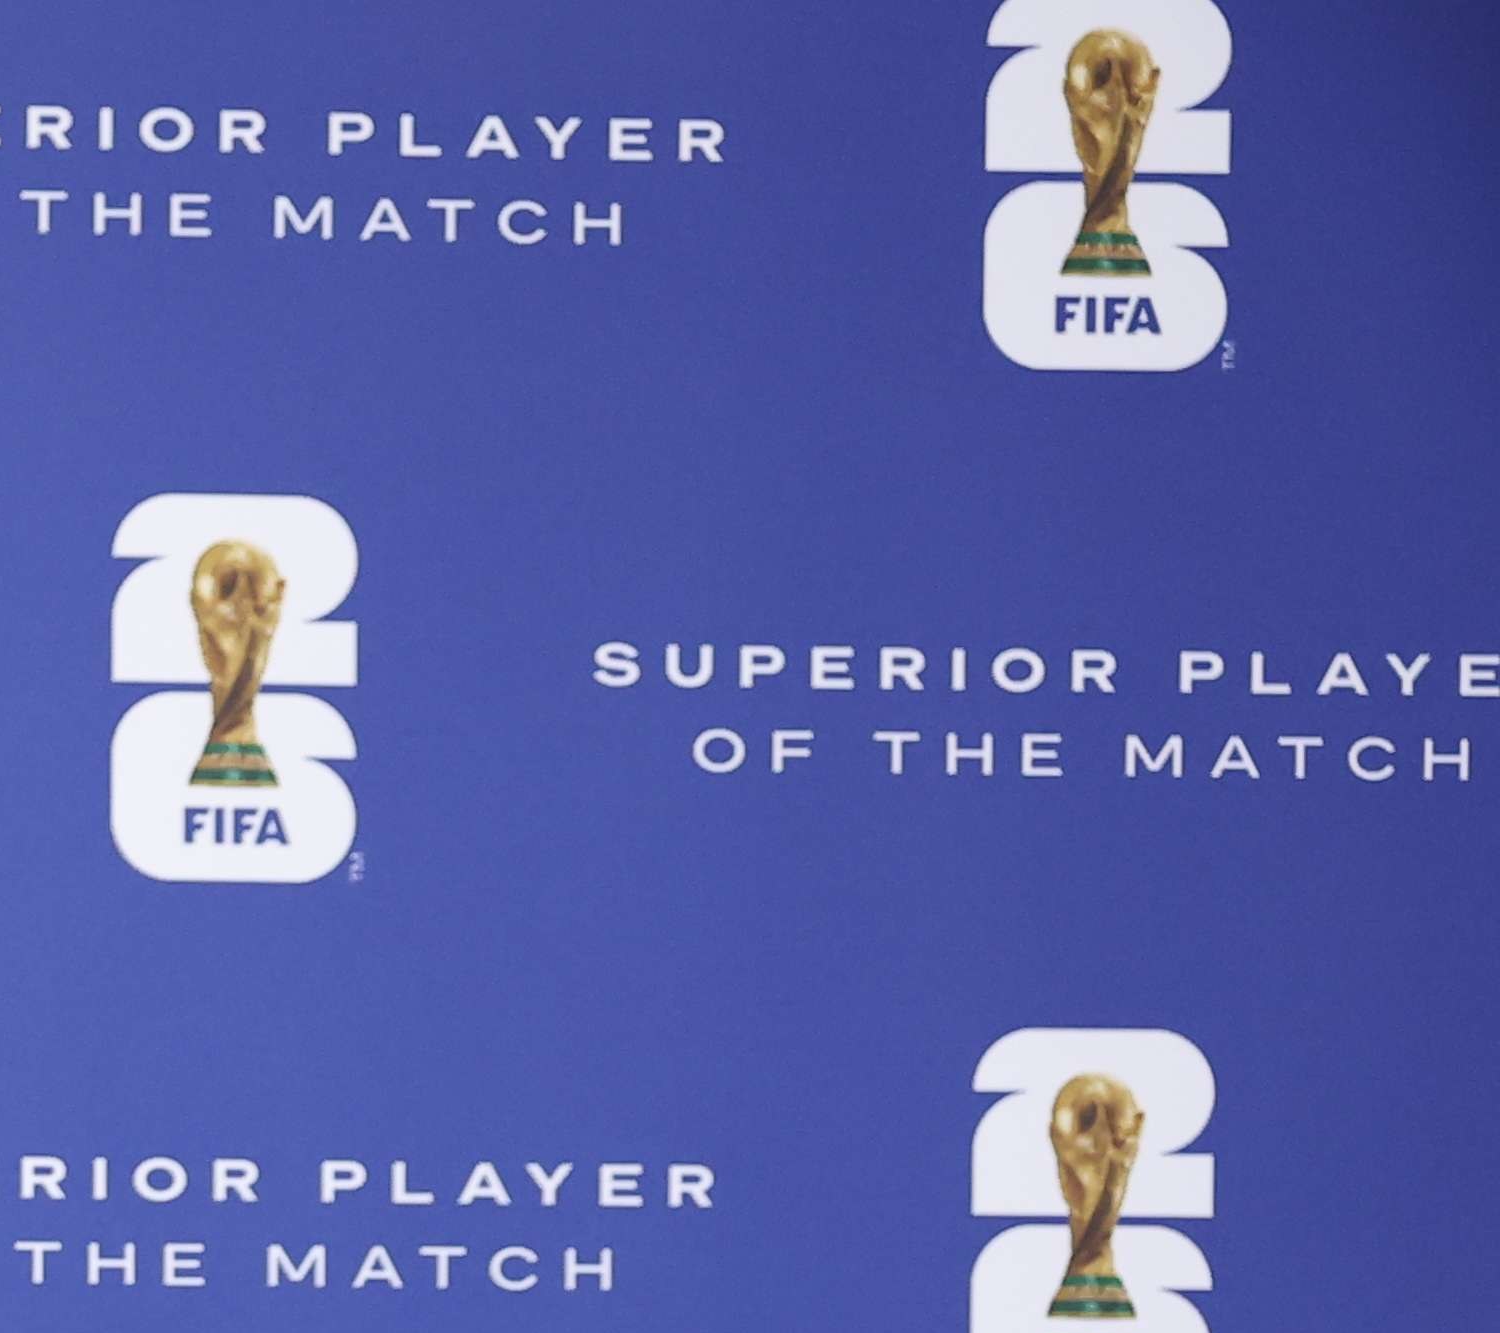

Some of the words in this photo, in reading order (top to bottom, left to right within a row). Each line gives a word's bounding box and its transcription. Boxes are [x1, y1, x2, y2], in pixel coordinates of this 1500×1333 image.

[327, 111, 725, 164] PLAYER
[18, 189, 213, 238] THE
[273, 194, 623, 247] MATCH
[1053, 295, 1162, 336] FIFA
[592, 641, 1118, 694] SUPERIOR
[1178, 649, 1500, 698] PLAYE
[692, 727, 815, 774] OF
[872, 730, 1064, 778] THE
[1124, 733, 1471, 782] MATCH
[183, 806, 287, 846] FIFA
[319, 1159, 715, 1209] PLAYER
[13, 1240, 207, 1287] THE
[266, 1243, 613, 1292] MATCH
